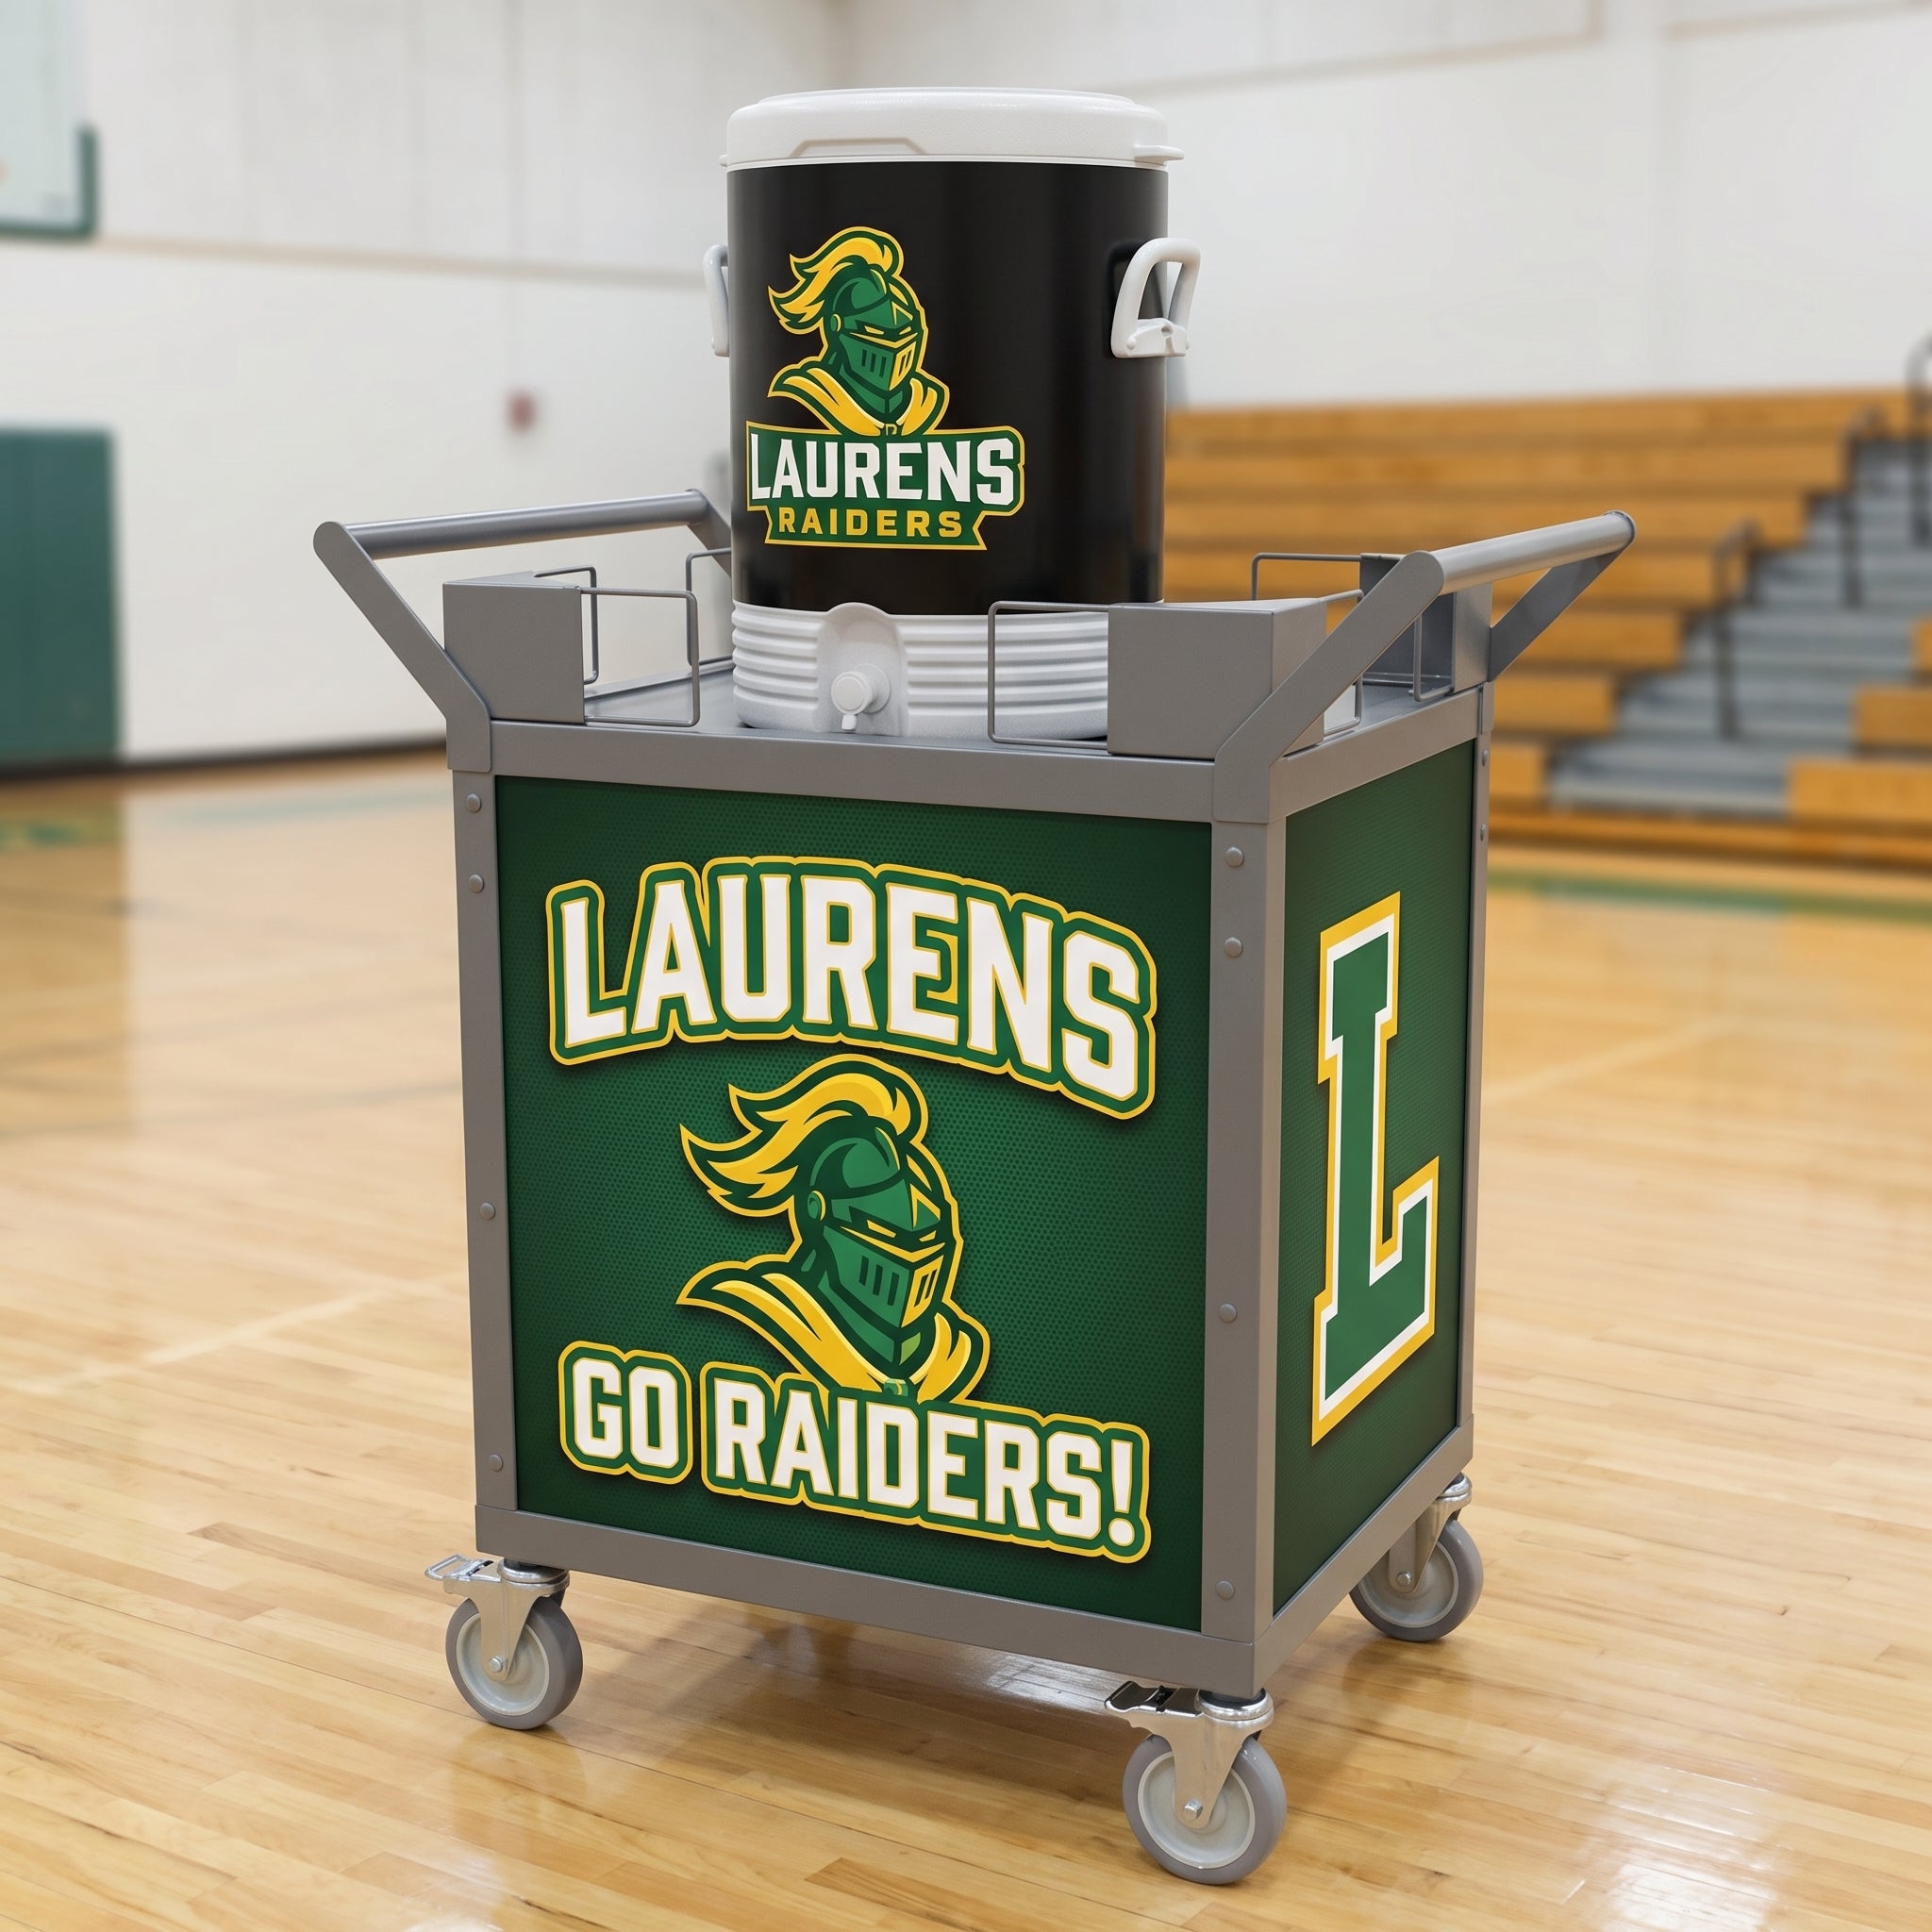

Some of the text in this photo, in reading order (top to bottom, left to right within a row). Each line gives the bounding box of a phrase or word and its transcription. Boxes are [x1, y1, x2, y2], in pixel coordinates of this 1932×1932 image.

[750, 432, 1014, 507] LAURENS
[777, 506, 963, 538] RAIDERS
[558, 873, 1141, 1102] LAURENS
[1311, 891, 1440, 1447] L
[571, 1356, 1136, 1547] GO RAIDERS!
